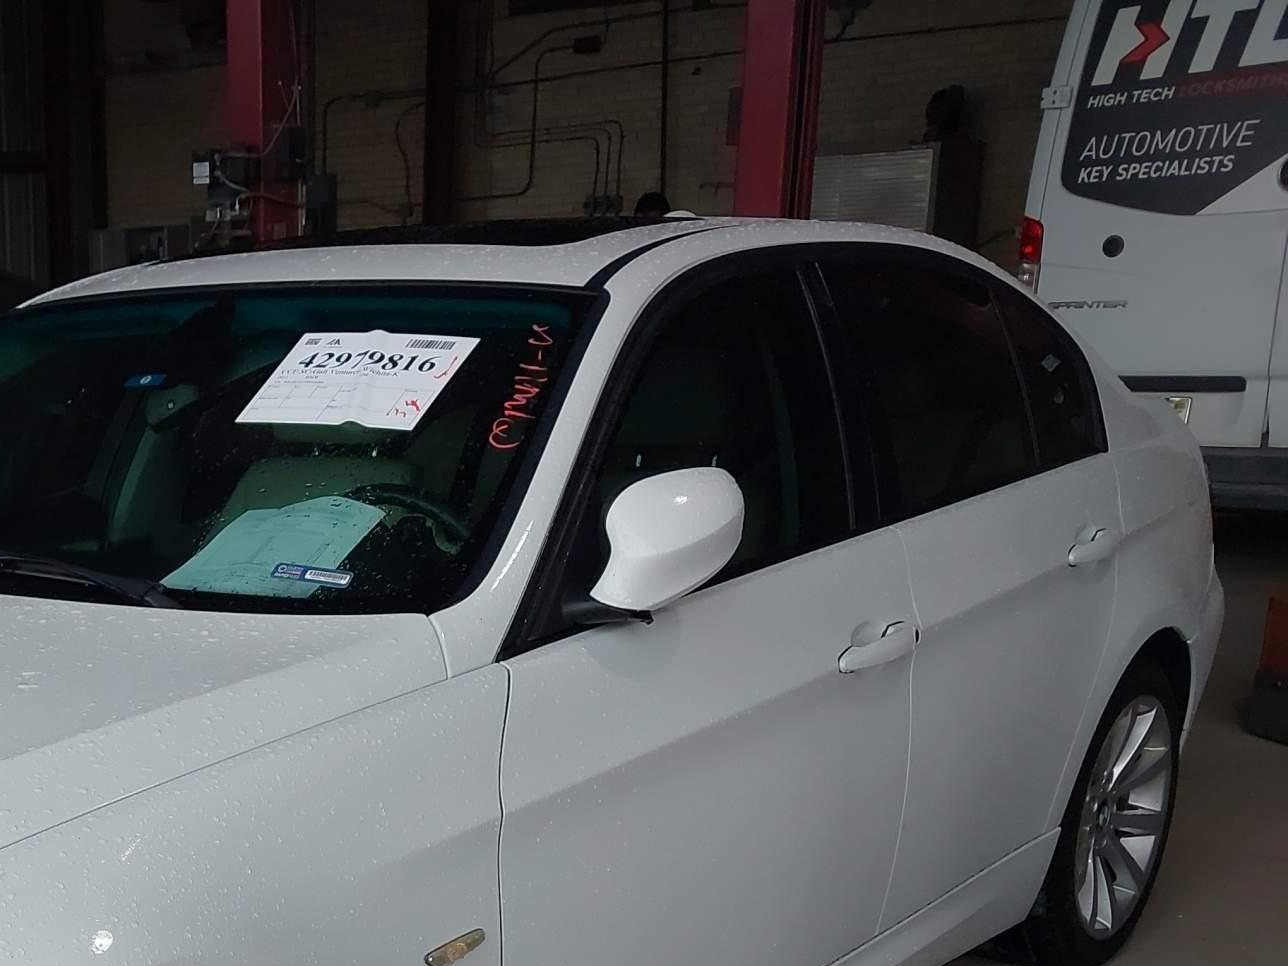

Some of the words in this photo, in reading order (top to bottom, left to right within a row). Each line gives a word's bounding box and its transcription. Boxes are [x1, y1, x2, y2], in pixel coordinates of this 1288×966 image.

[1087, 91, 1127, 109] HIGH
[1132, 85, 1176, 104] TECH
[1080, 119, 1260, 160] AUTOMOTIVE
[1078, 164, 1113, 183] KEY
[1115, 155, 1235, 181] SPECIALISTS
[298, 350, 442, 373] 42979816
